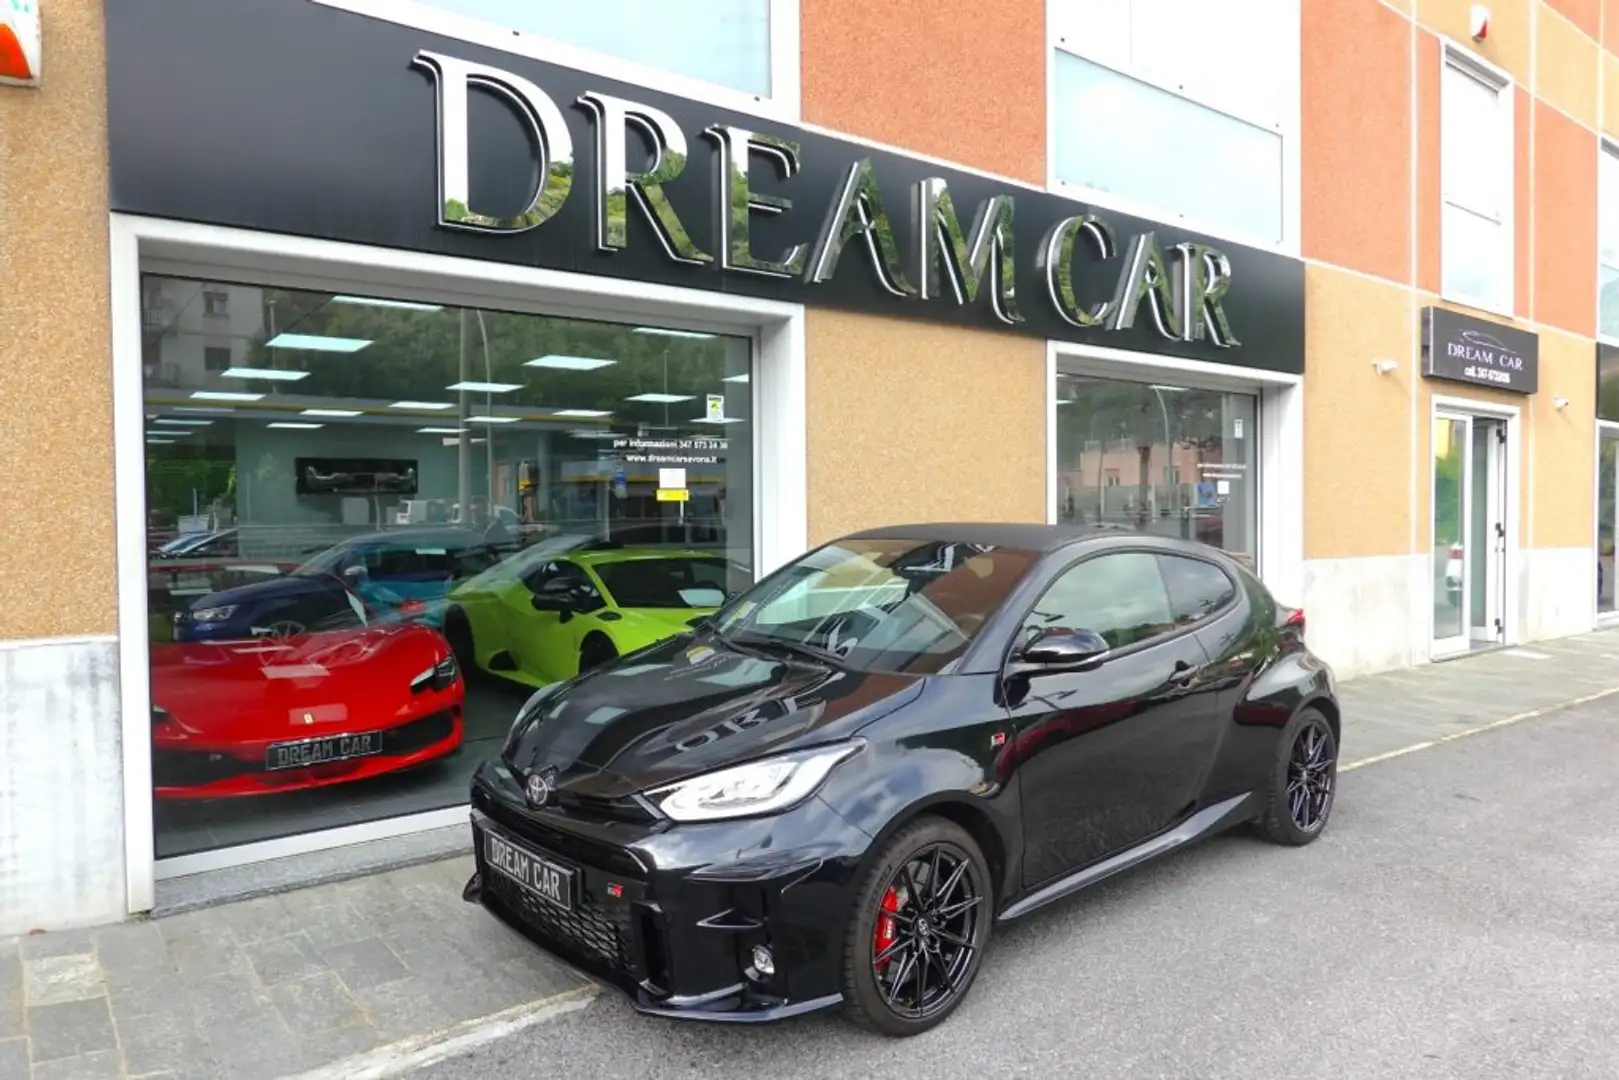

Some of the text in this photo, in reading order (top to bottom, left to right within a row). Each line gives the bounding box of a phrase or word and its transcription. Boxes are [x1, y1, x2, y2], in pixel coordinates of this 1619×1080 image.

[412, 49, 1241, 348] DREAM CAR
[1448, 342, 1523, 371] DREAM CAR
[613, 439, 627, 449] per
[277, 735, 372, 766] DREAM CAR
[491, 837, 561, 901] DREAM CAR
